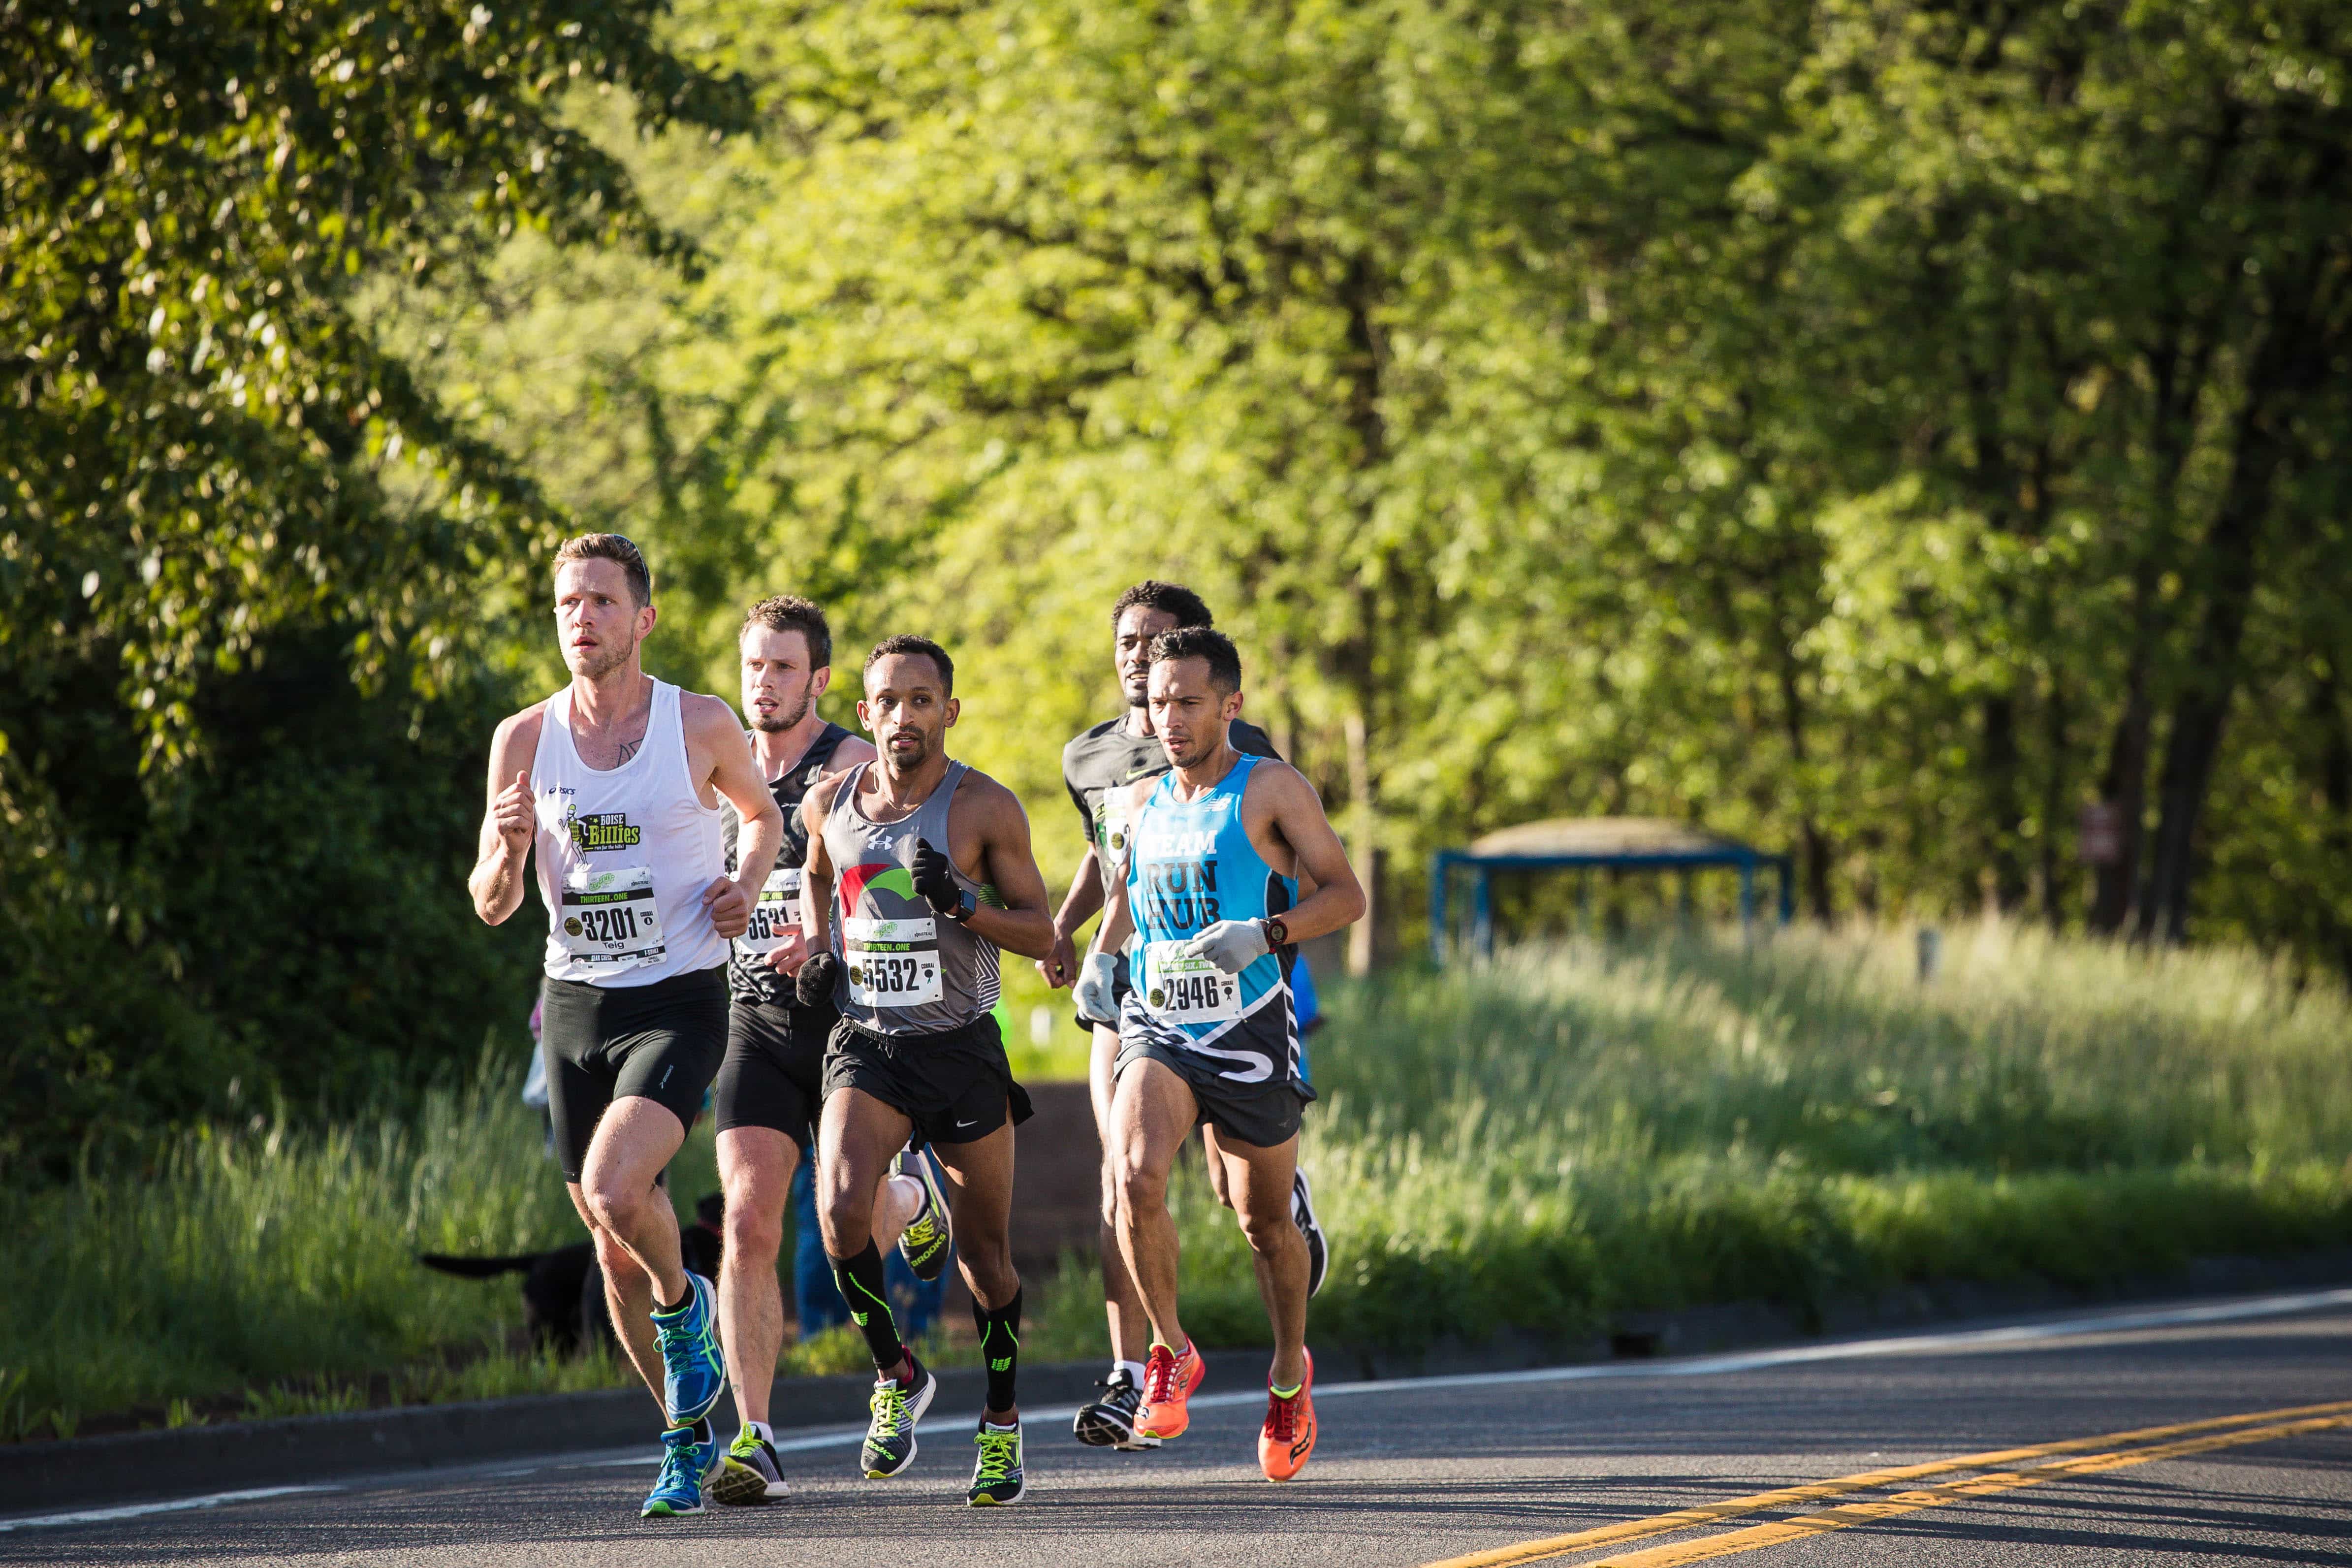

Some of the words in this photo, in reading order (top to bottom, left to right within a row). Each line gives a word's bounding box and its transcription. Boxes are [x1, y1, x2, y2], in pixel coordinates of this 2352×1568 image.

[588, 824, 639, 845] Billies
[600, 814, 624, 826] BOISE
[1145, 830, 1218, 859] TEAM
[1145, 860, 1217, 895] RUN
[581, 906, 638, 942] 3201
[1147, 897, 1221, 930] HUB
[862, 958, 920, 992] 5532
[1163, 975, 1219, 1011] 2946
[910, 1233, 946, 1267] BROOKS
